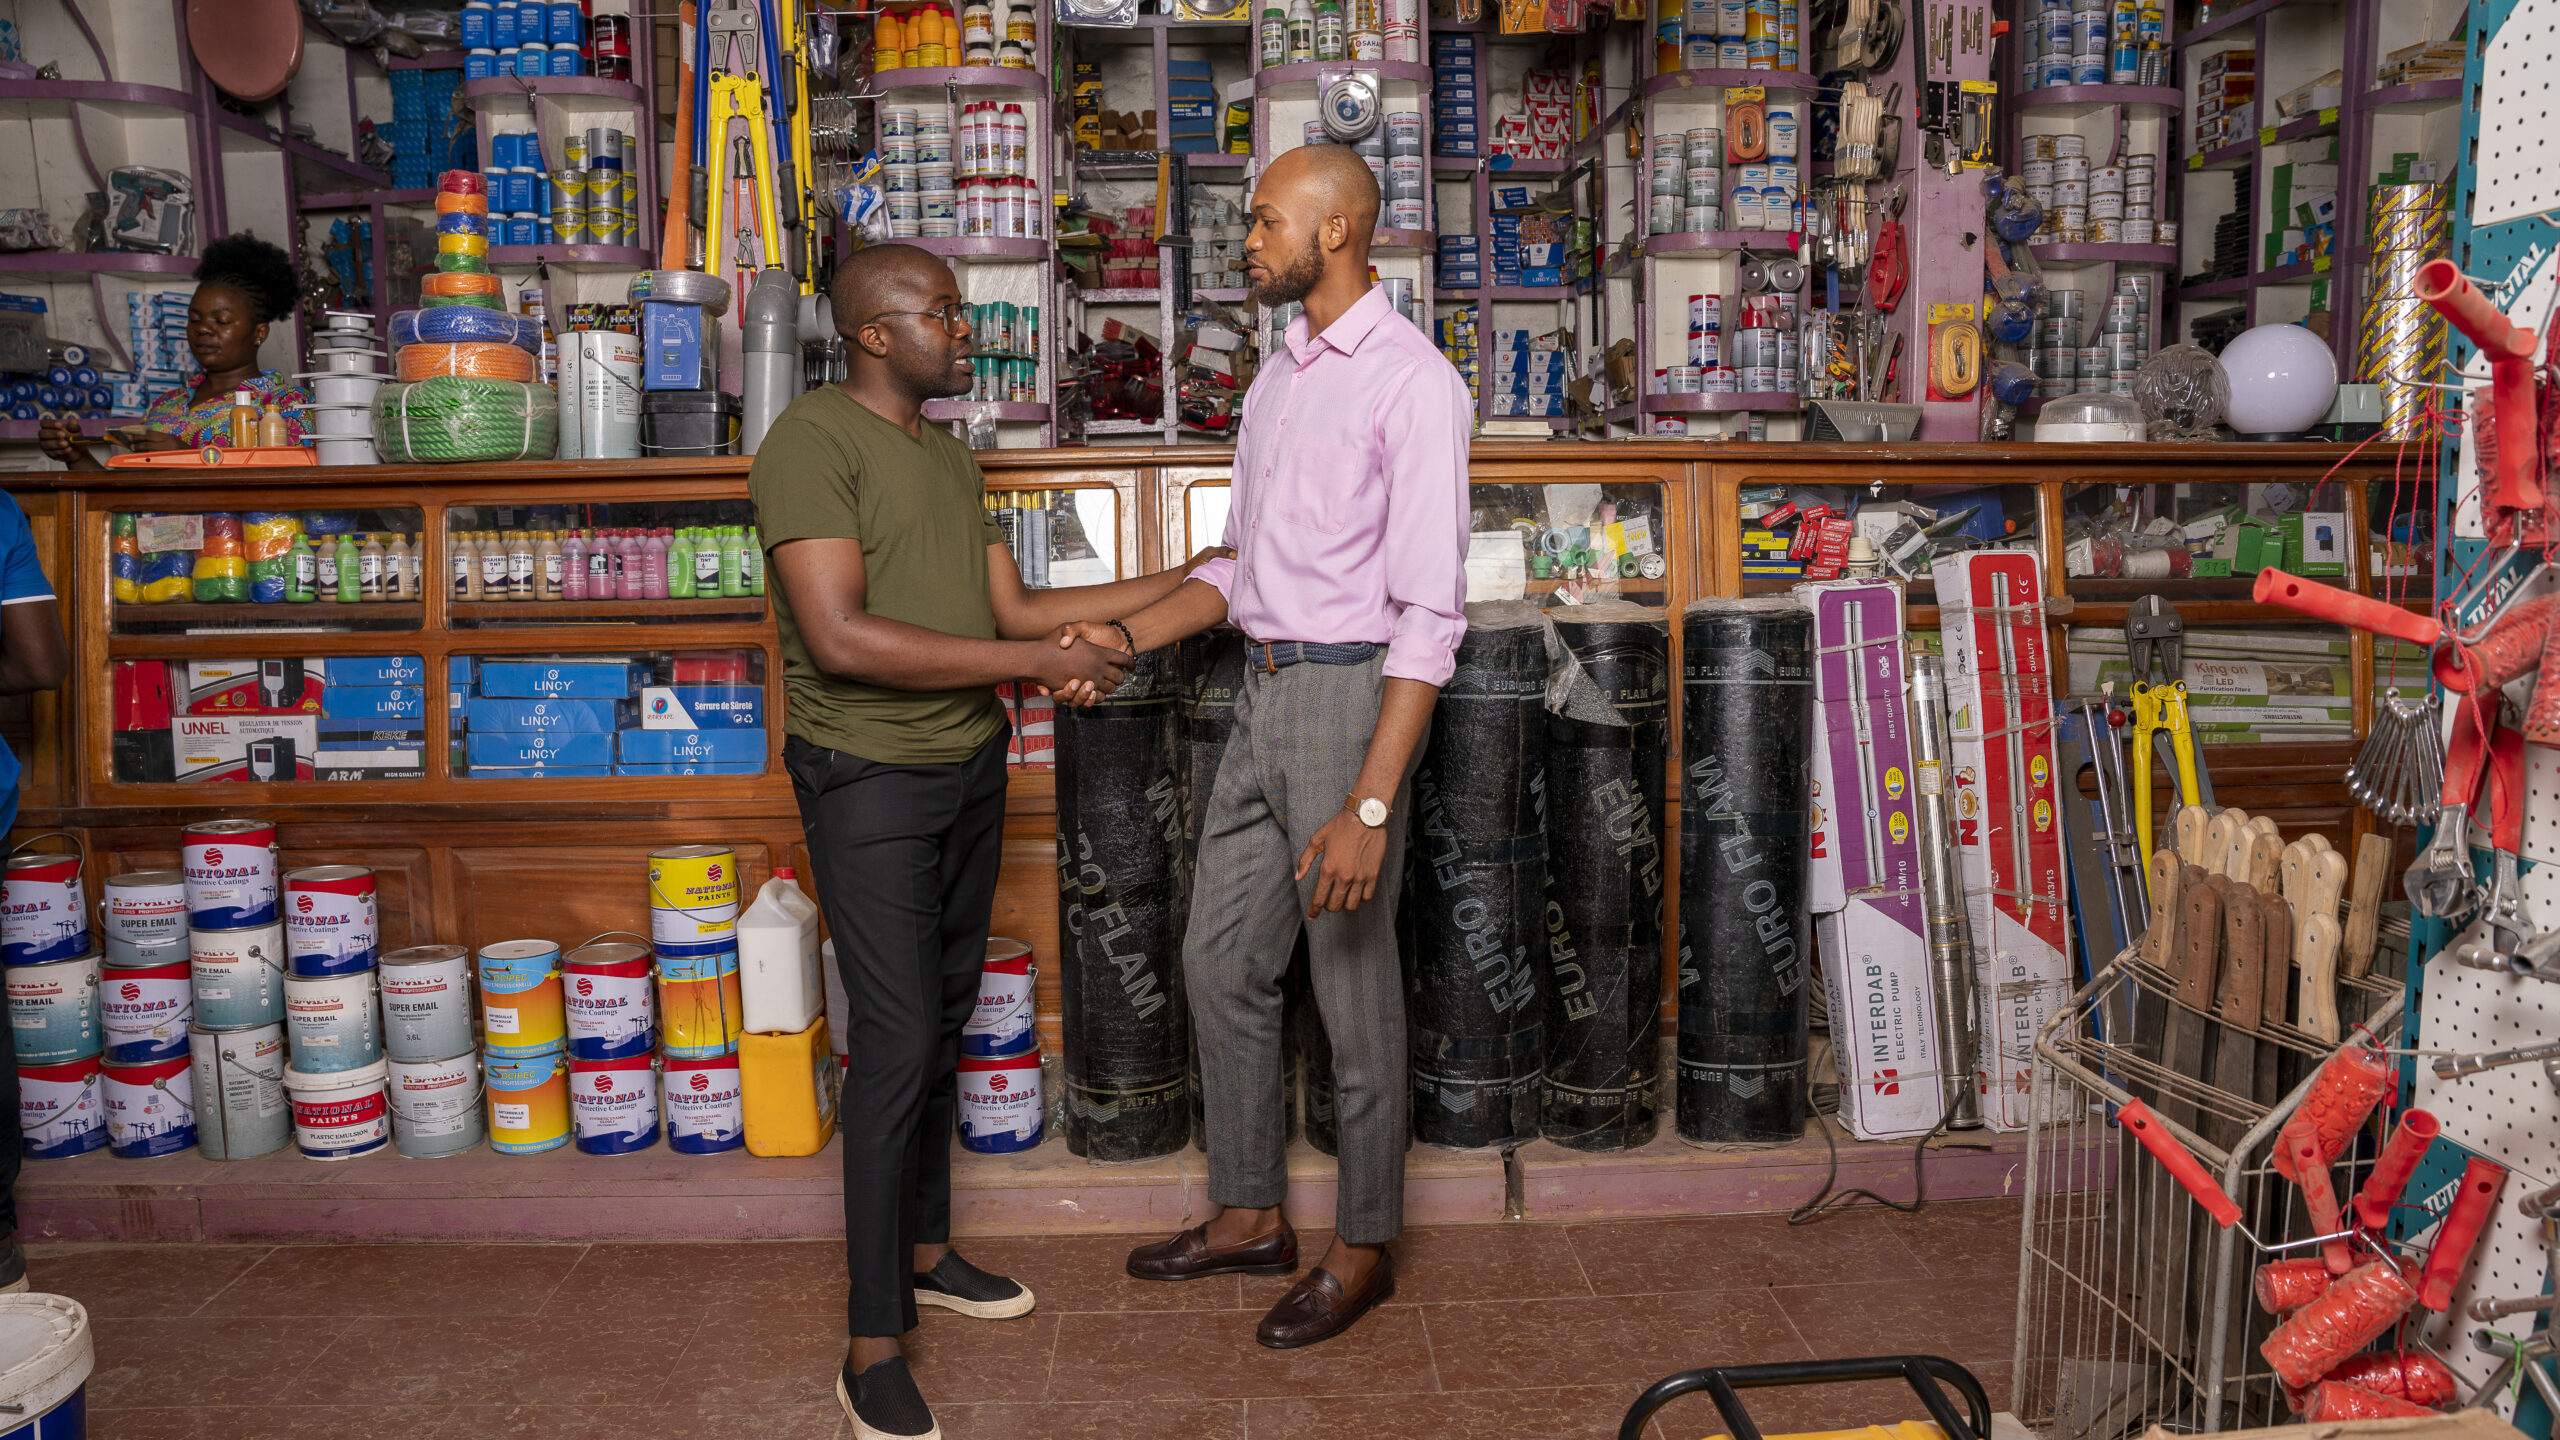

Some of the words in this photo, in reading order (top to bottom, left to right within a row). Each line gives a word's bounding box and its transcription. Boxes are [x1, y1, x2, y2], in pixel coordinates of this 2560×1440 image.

[568, 314, 594, 322] HKS
[610, 314, 635, 323] HKS
[2027, 636, 2038, 672] QUALITY
[378, 668, 415, 679] LINCY
[2194, 663, 2227, 676] King
[2231, 665, 2248, 675] on
[534, 680, 572, 691] LINCY
[2215, 678, 2234, 686] LED
[1621, 688, 1648, 699] FLAM
[695, 701, 720, 710] Serrure
[721, 702, 729, 710] de
[731, 701, 753, 710] Sûreté
[1883, 688, 1894, 718] QUALITY
[2211, 695, 2236, 705] LED
[377, 701, 414, 712] LINCY
[521, 715, 559, 726] LINCY
[373, 730, 408, 741] KEKE
[2204, 733, 2228, 744] LED
[520, 749, 558, 759] LINCY
[673, 745, 711, 756] LINCY
[1690, 754, 1763, 873] FLAM
[1743, 879, 1805, 997] EURO
[218, 878, 249, 886] Coatings
[685, 880, 736, 895] NATIONAL
[698, 892, 731, 902] PAINTS
[6, 914, 39, 922] Coatings
[120, 919, 148, 928] SUPER
[150, 917, 177, 927] EMAIL
[309, 926, 339, 934] Coatings
[1090, 901, 1166, 1020] FLAM
[1453, 898, 1514, 1013] EURO
[1545, 900, 1599, 1022] EURO
[1890, 971, 1900, 1002] PUMP
[25, 997, 54, 1006] EMAIL
[389, 1003, 410, 1012] SUPER
[412, 1001, 438, 1011] EMAIL
[588, 1008, 618, 1017] Coatings
[976, 1006, 1006, 1014] Coatings
[1866, 964, 1890, 1064] INTERDAB
[1914, 985, 1925, 1034] TECHNOLOGY
[106, 1013, 133, 1021] Protective
[135, 1011, 168, 1020] Coatings
[292, 1015, 312, 1023] SUPER
[1893, 1006, 1906, 1061] ELECTRIC
[1919, 1036, 1927, 1059] ITALY
[1693, 1069, 1723, 1081] EURO
[572, 1088, 646, 1105] NATIONAL
[667, 1088, 741, 1104] NATIONAL
[963, 1087, 1036, 1104] NATIONAL
[1590, 1094, 1621, 1107] EURO
[295, 1098, 374, 1115] NATIONAL
[579, 1104, 607, 1113] Protective
[608, 1103, 637, 1112] Coatings
[674, 1103, 702, 1112] Protective
[703, 1100, 732, 1111] Coatings
[971, 1102, 1001, 1111] Protective
[1003, 1102, 1029, 1111] Coatings
[310, 1114, 358, 1124] PAINTS
[335, 1129, 368, 1139] EMULSION
